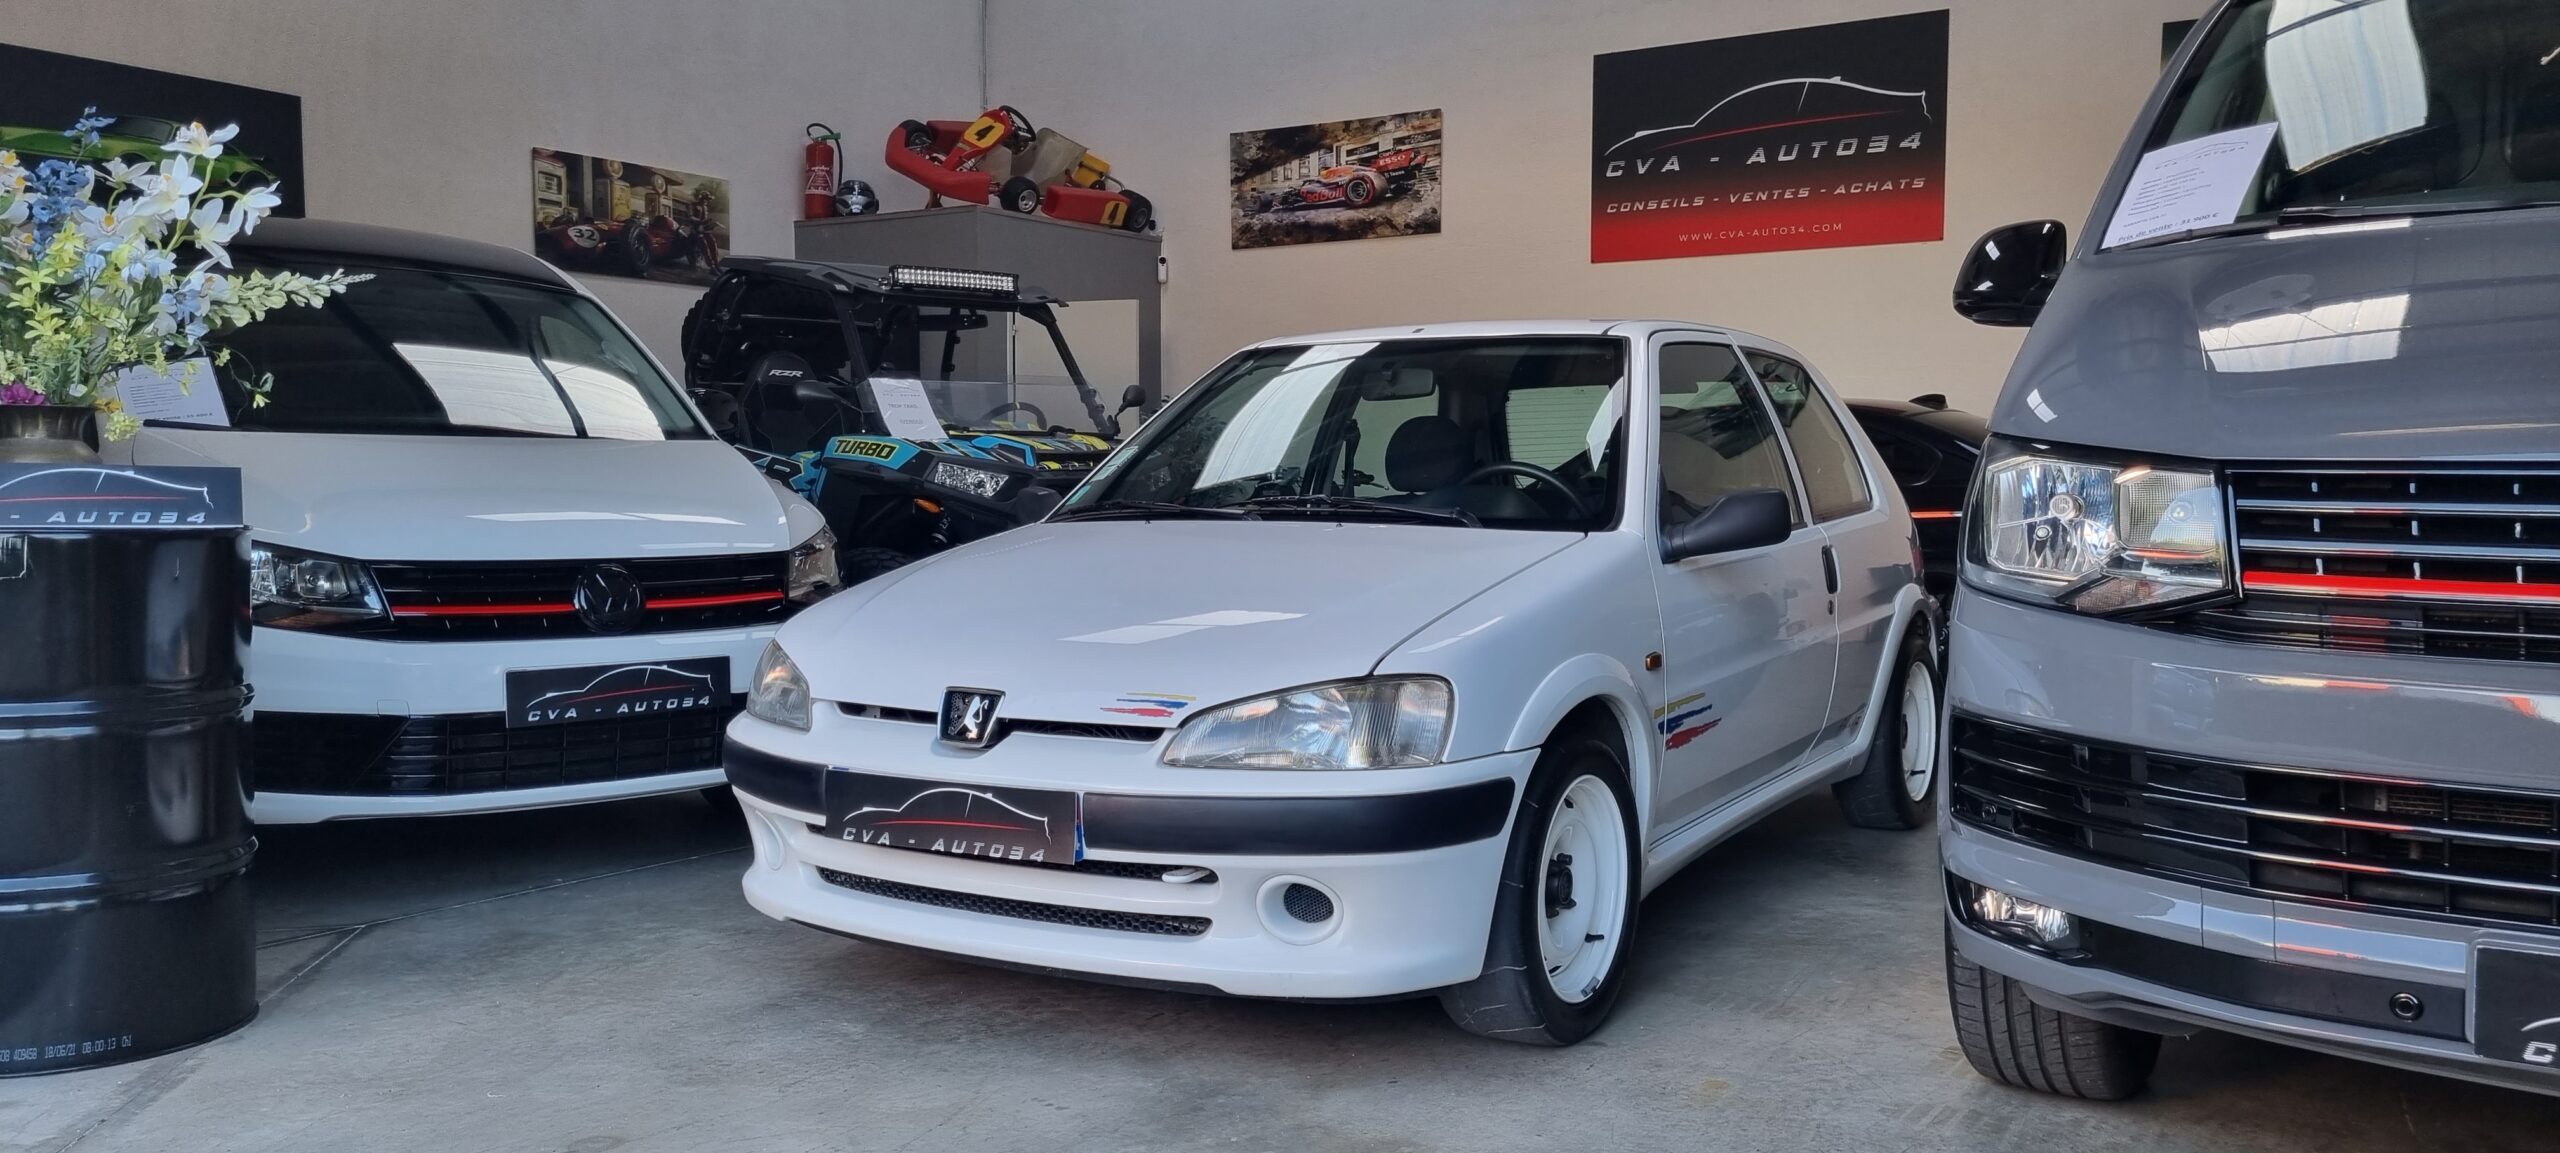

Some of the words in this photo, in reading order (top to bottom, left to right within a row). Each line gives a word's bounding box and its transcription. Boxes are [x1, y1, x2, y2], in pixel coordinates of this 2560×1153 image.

[1605, 155, 1682, 178] CVA
[1745, 132, 1923, 165] AUTO34
[1606, 195, 1705, 213] CONSEILS
[1729, 187, 1812, 204] VENTES
[1833, 177, 1927, 195] ACHATS
[573, 227, 597, 242] 32
[1678, 222, 1844, 242] WWW.CVA-AUTO34.COM
[768, 369, 804, 378] RZR
[833, 438, 900, 460] TURBO
[46, 511, 207, 525] AUTO34
[527, 708, 579, 722] CVA
[616, 695, 711, 715] AUTO34
[842, 827, 891, 846] CVA
[930, 838, 1046, 863] AUTO34
